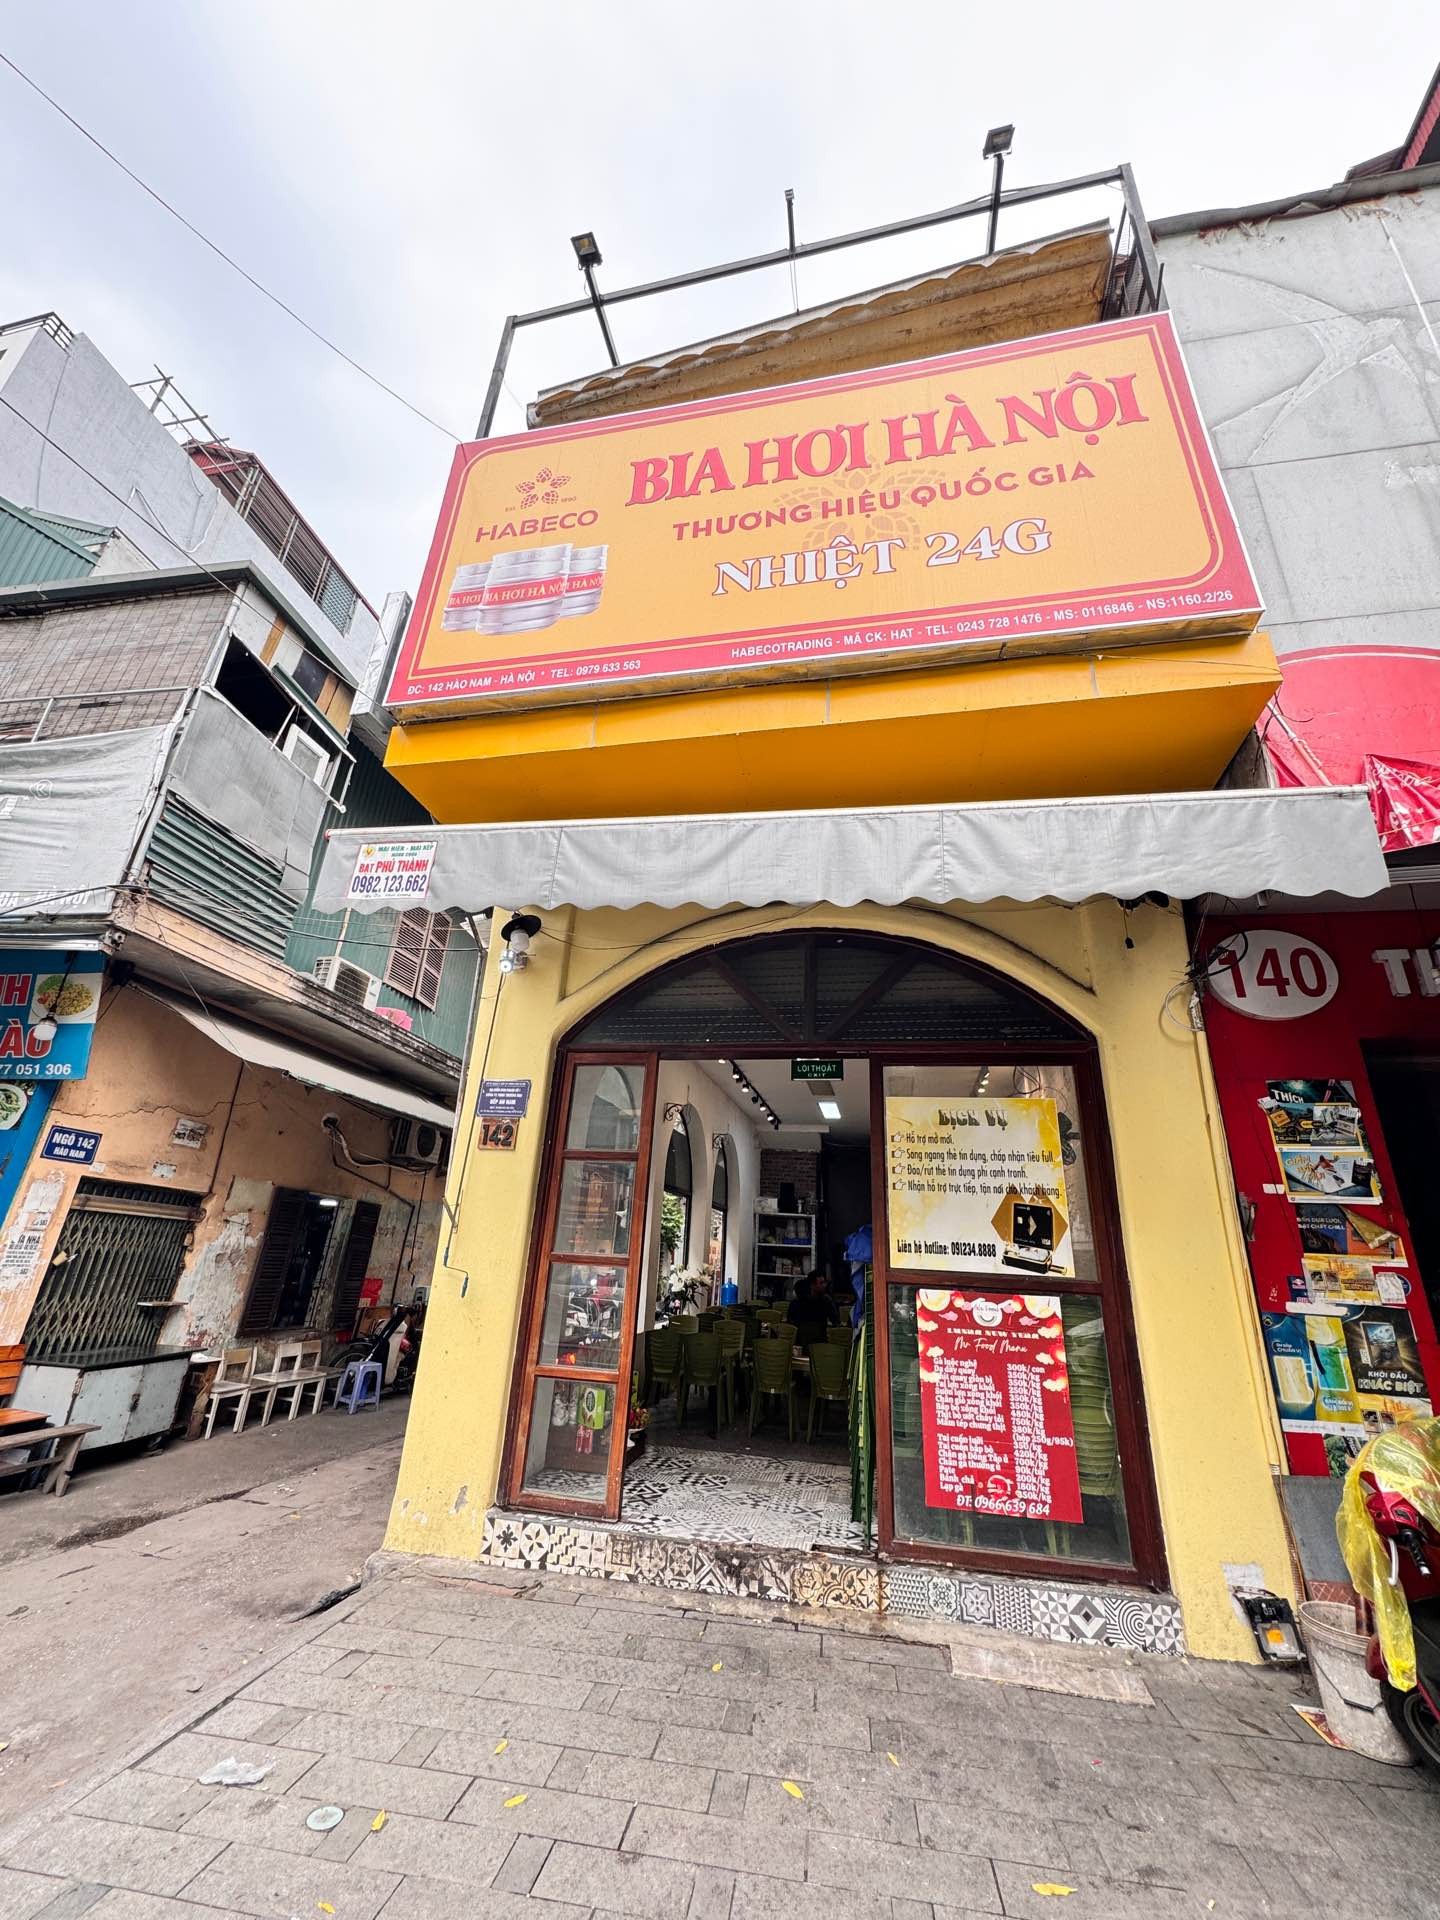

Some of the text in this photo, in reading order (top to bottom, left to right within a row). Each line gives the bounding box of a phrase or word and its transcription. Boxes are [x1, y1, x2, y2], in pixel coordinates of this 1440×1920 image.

[624, 371, 1149, 507] BIA HƠI HÀ NỘI
[673, 460, 1096, 541] THƯƠNG HIỆU QUỐC GIA
[475, 510, 599, 543] HABECO
[712, 517, 1053, 597] NHIỆT 24G
[731, 637, 833, 658] HABECOTRADING
[844, 633, 861, 646] MÃ
[865, 631, 887, 643] CK:
[891, 627, 914, 641] HAT
[926, 624, 953, 637] TEL:
[957, 619, 985, 633] 0243
[989, 617, 1010, 629] 728
[1014, 612, 1042, 625] 1476
[1054, 608, 1078, 621] MS:
[1082, 601, 1135, 618] 0116846
[407, 659, 641, 695] ĐC: 142 HÀO NAM HÀ NỘI TEL: 0979 633 563
[351, 873, 427, 893] 0982.123.662
[1218, 947, 1327, 998] 140
[16, 1063, 40, 1075] 051
[45, 1063, 72, 1075] 306
[78, 1136, 95, 1150] 142
[482, 1124, 514, 1146] 142
[906, 1131, 915, 1143] Hỗ
[69, 1149, 86, 1159] NAM
[907, 1148, 922, 1161] Sang
[925, 1151, 944, 1162] ngang
[924, 1240, 949, 1255] hotline:
[974, 1495, 1002, 1509] 0966
[1005, 1500, 1026, 1512] 639
[1028, 1502, 1050, 1515] 684
